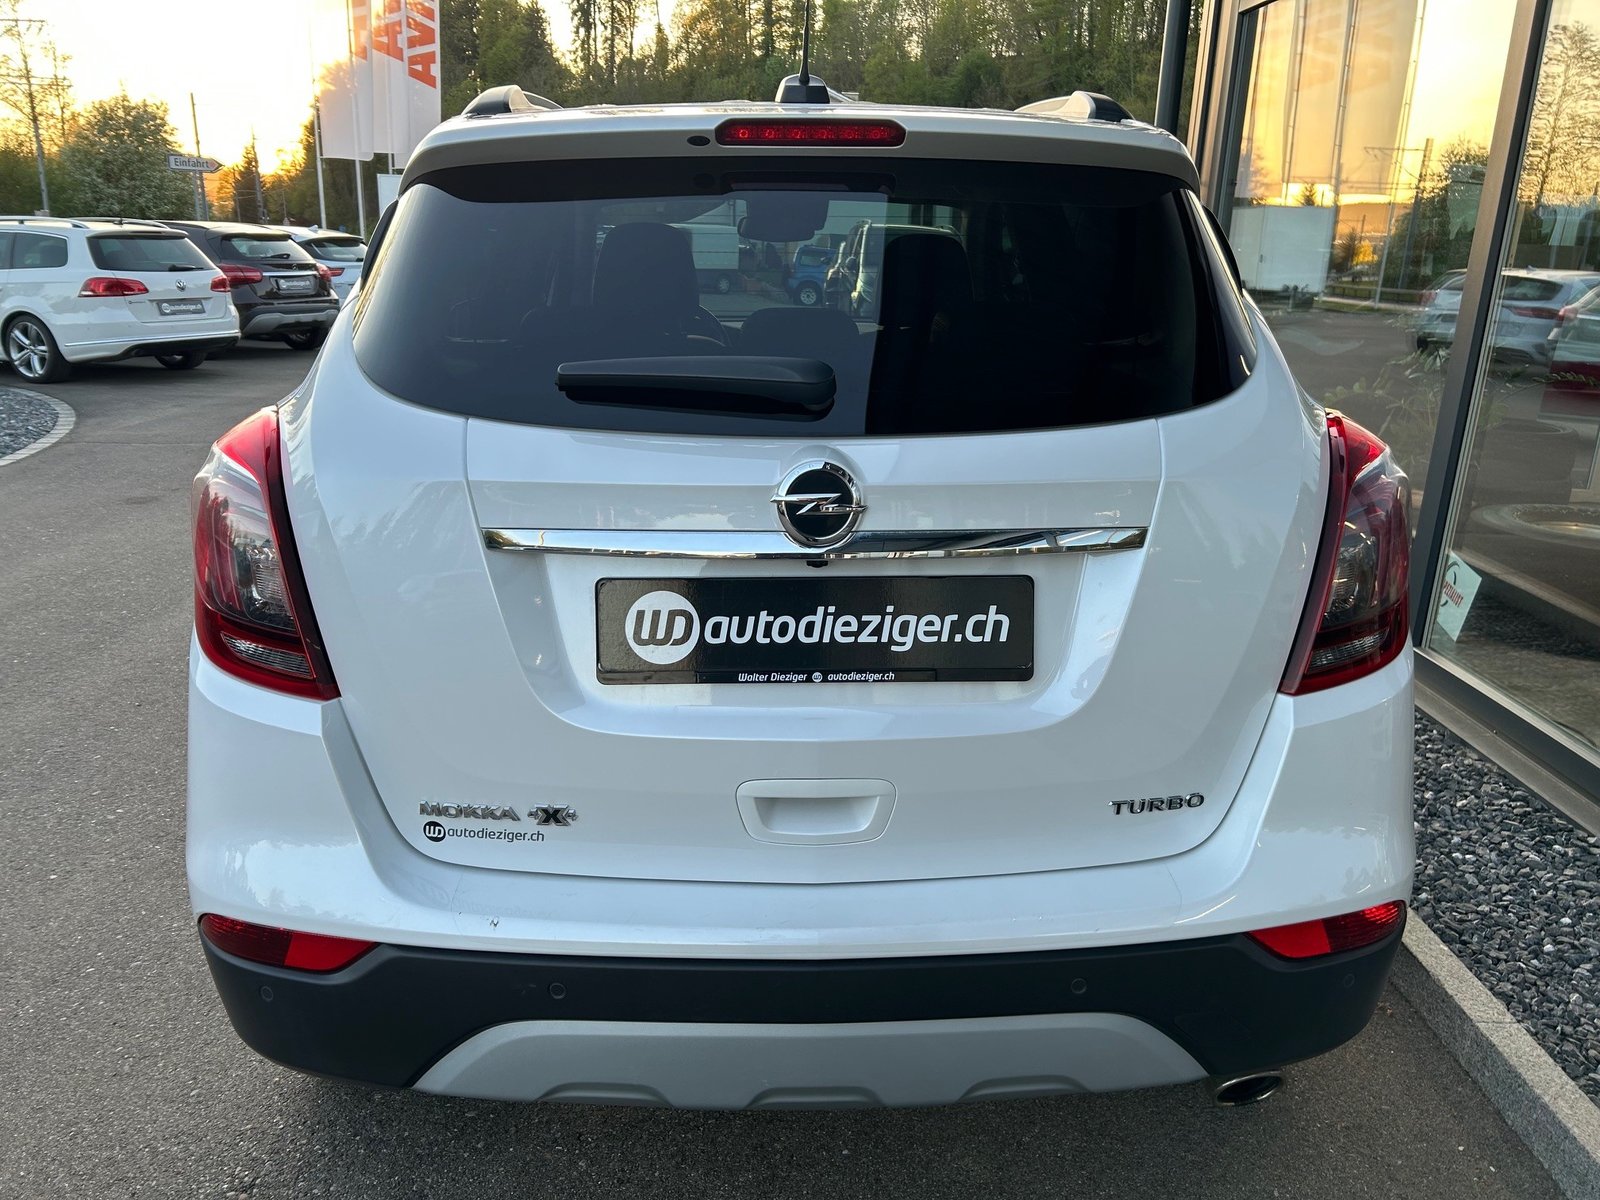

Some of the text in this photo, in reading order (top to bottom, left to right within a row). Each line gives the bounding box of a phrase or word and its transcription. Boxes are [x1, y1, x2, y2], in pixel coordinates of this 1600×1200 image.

[173, 157, 209, 168] Einfahrt
[703, 604, 1010, 652] autodieziger.ch
[738, 672, 769, 682] Walter
[770, 672, 807, 683] Dieziger
[827, 671, 895, 682] autodieziger.ch
[419, 800, 521, 822] MOKKA
[1108, 792, 1205, 815] TURBO
[447, 827, 545, 842] autodieziger.ch
